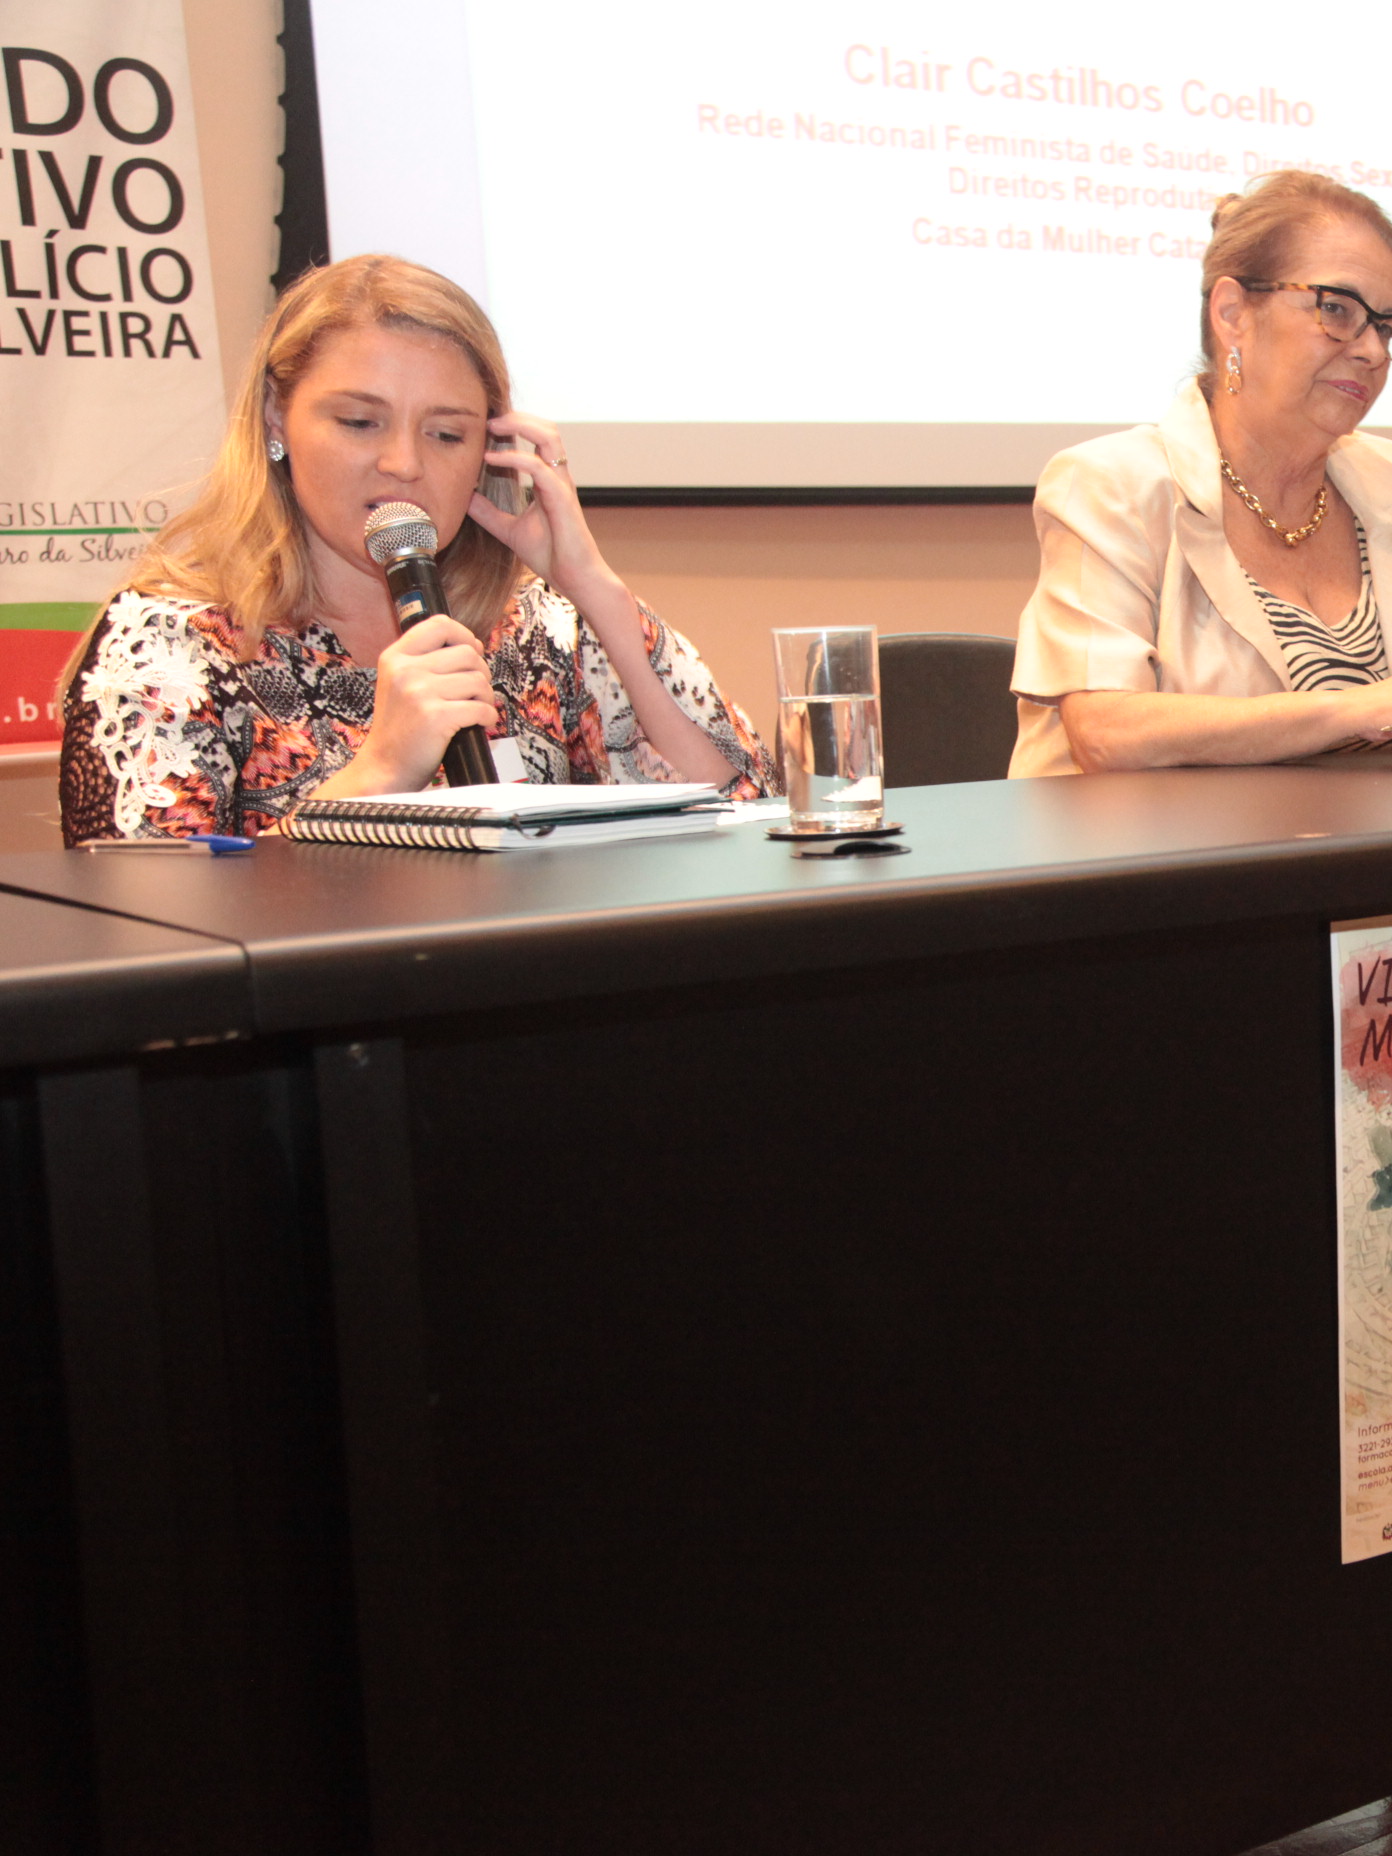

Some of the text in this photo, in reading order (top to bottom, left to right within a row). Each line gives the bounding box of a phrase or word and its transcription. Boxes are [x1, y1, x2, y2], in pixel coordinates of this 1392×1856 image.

[1, 47, 174, 145] DO
[843, 44, 1315, 128] Clair Castilhos Coelho
[697, 104, 785, 141] Rede
[794, 113, 936, 151] Nacional
[944, 126, 1091, 164] Feminista
[1099, 139, 1134, 167] de
[949, 167, 1066, 201] Direitos
[912, 218, 990, 246] Casa
[998, 223, 1033, 250] da
[1042, 226, 1141, 257] Mulher
[0, 229, 193, 304] LÍCIO
[39, 536, 73, 563] da
[3, 696, 57, 723] .br
